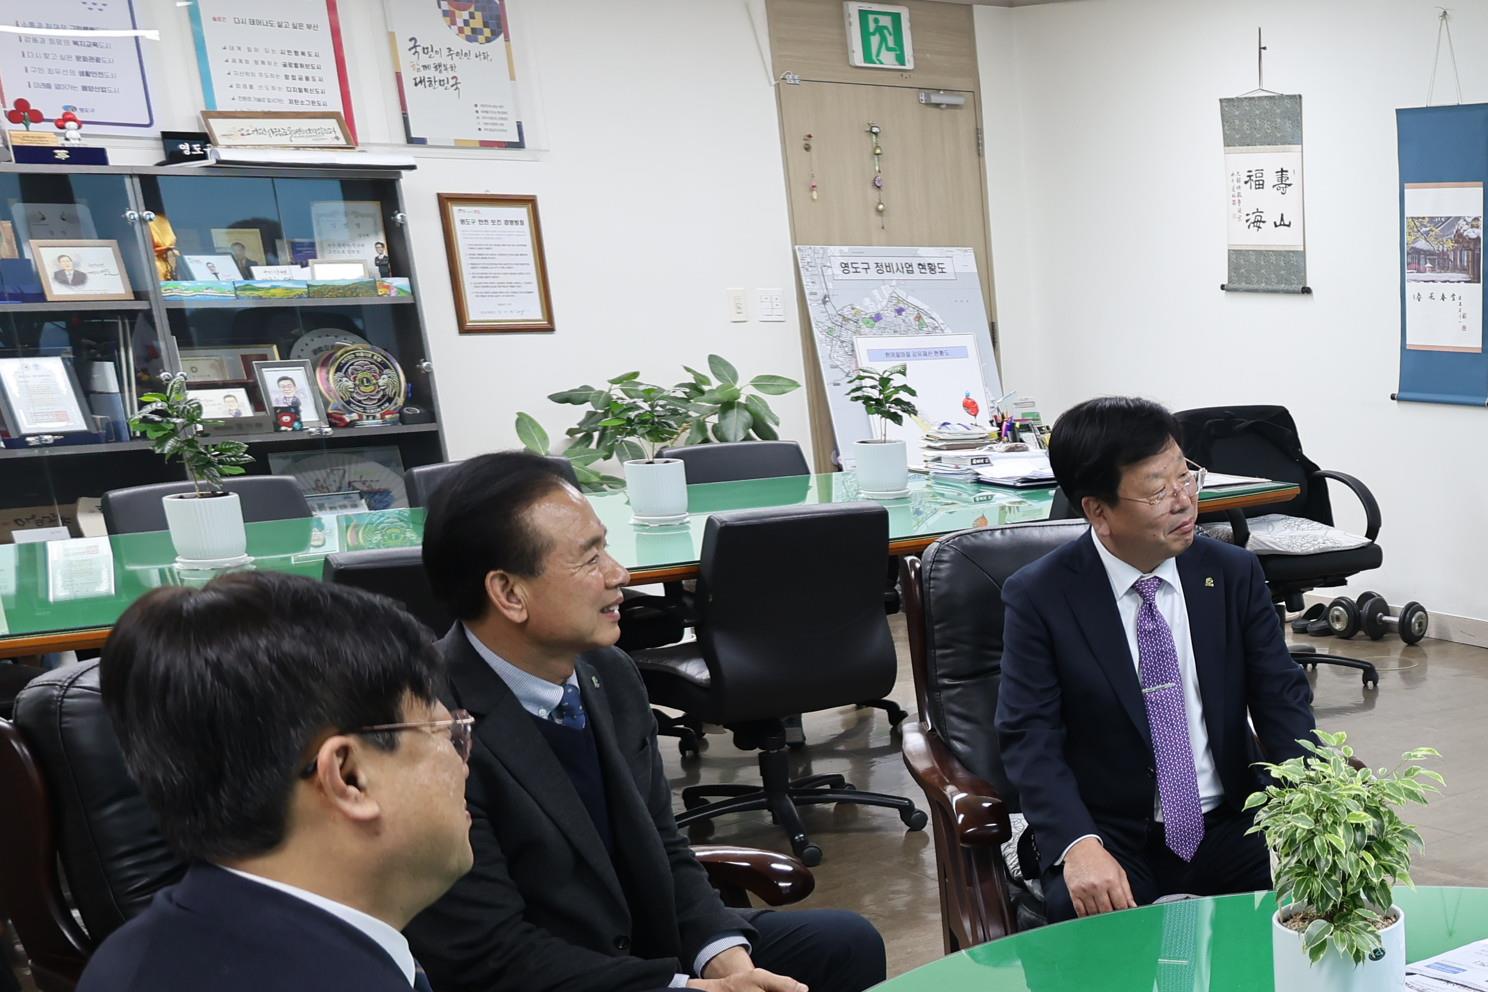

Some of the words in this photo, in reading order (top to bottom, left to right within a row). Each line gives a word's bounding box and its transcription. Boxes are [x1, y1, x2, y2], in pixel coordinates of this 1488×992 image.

[408, 37, 442, 60] 국민이
[446, 47, 471, 61] 주인인
[413, 75, 461, 99] 대한민국
[840, 262, 870, 274] 영도구
[874, 262, 914, 274] 정비사업
[917, 262, 948, 274] 현황도
